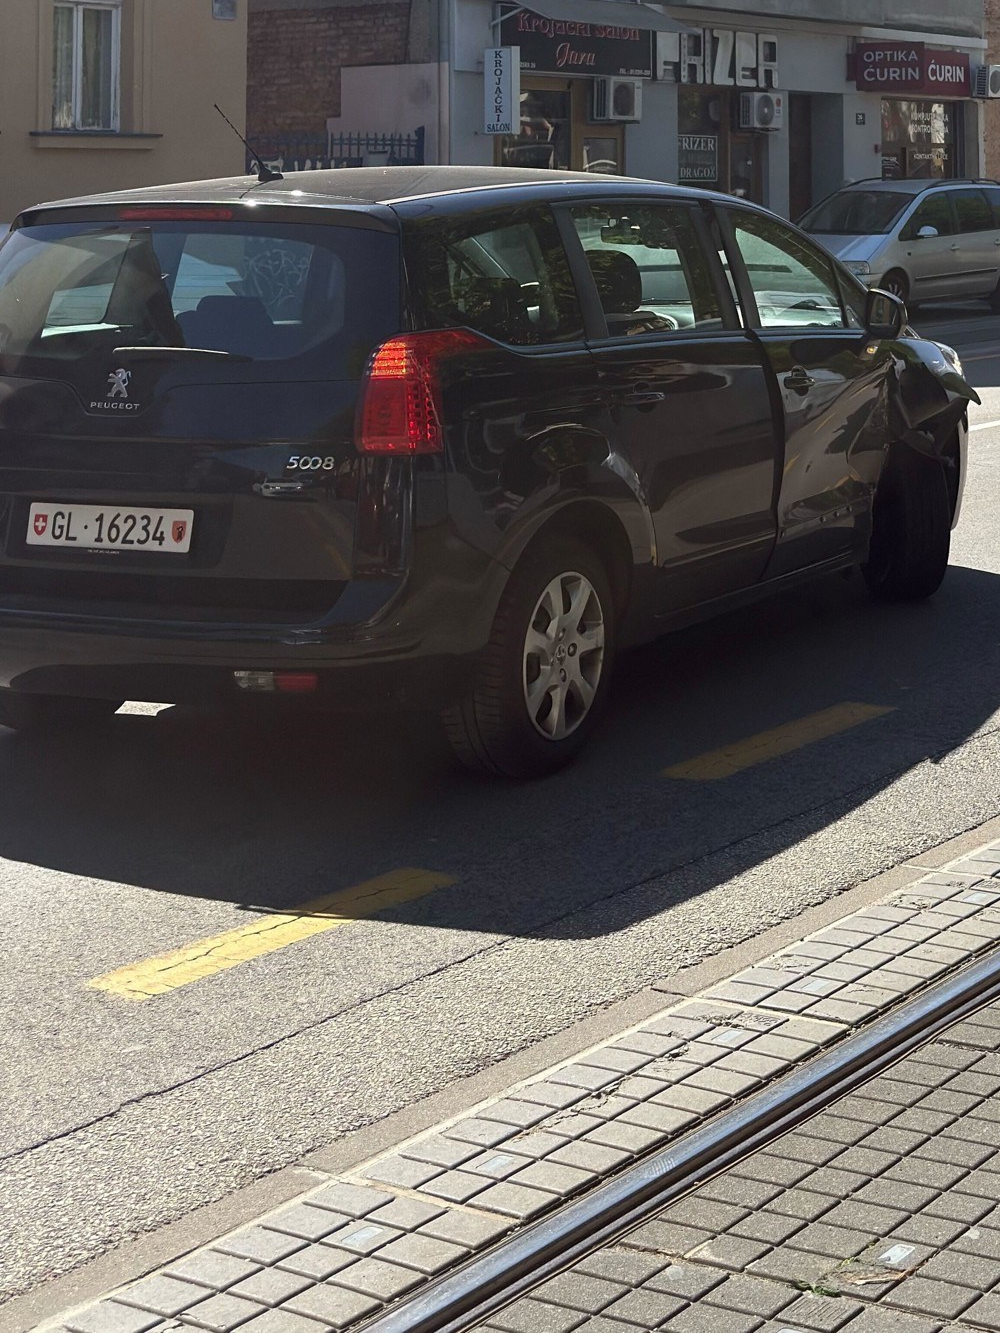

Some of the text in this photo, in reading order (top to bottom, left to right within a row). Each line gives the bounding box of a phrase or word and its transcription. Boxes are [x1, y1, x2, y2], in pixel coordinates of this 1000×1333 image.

[656, 28, 779, 88] FRIZER
[863, 50, 918, 63] OPTIKA
[863, 65, 920, 82] ĆURIN
[928, 60, 965, 83] ĆURIN
[487, 123, 511, 132] SALON
[90, 401, 140, 410] PEUGEOT
[286, 456, 335, 470] 5008
